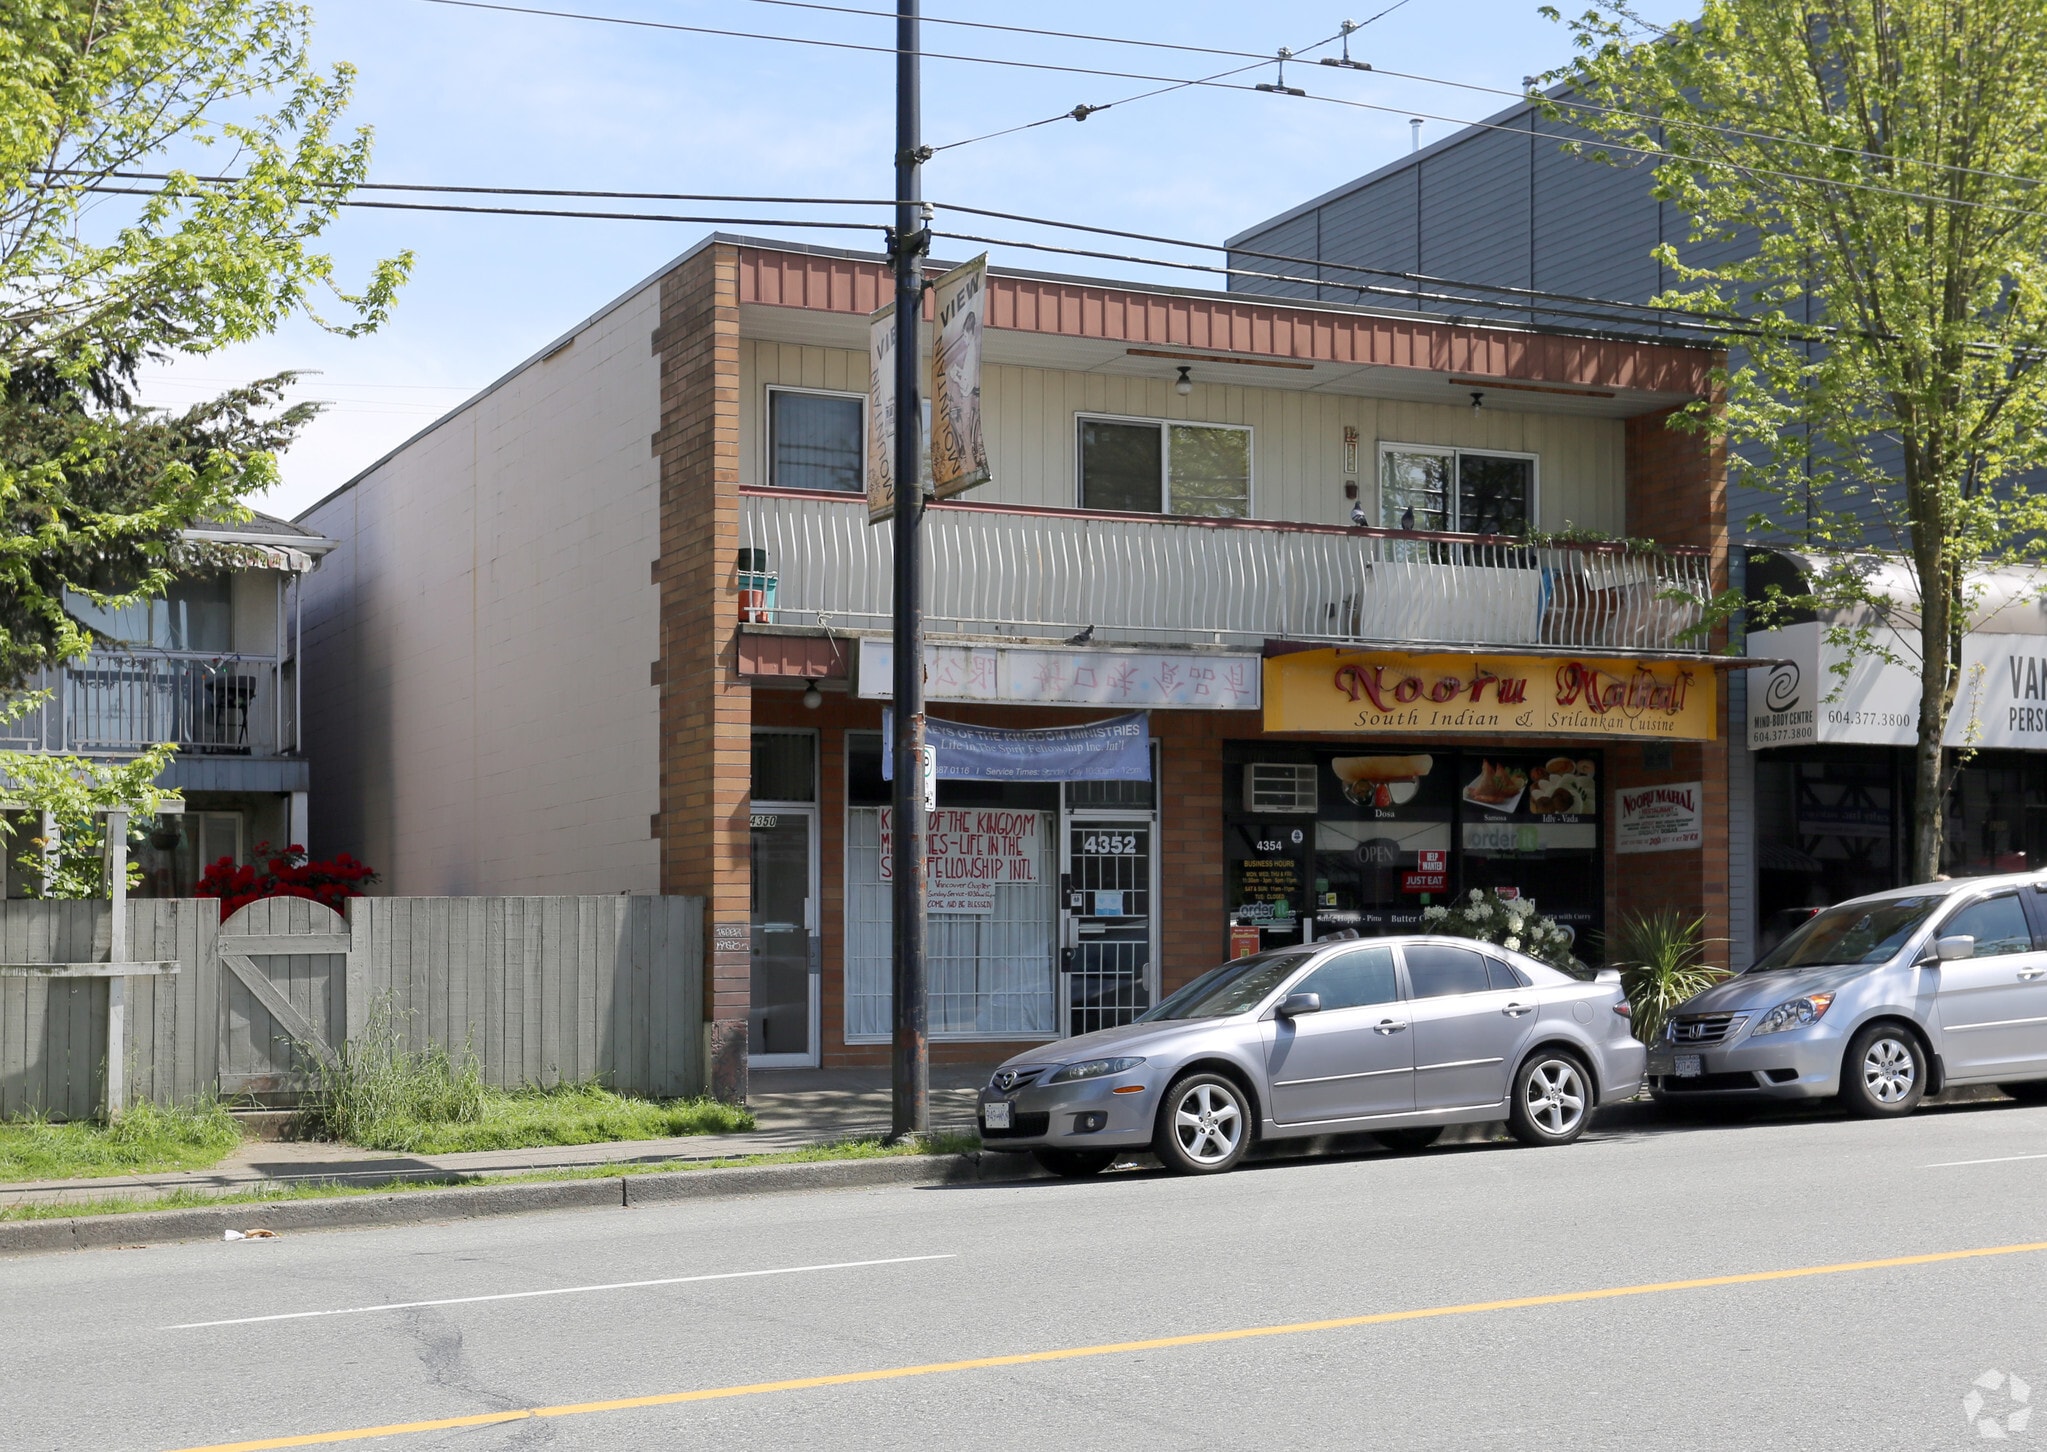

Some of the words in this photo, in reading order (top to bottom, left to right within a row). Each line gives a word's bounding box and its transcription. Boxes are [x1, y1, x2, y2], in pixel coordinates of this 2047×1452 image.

[940, 272, 980, 327] VIEW
[876, 324, 895, 361] VIE
[1334, 664, 1527, 712] Nooru
[1354, 709, 1418, 727] South
[1430, 709, 1499, 726] Indian
[1515, 710, 1533, 727] &
[1548, 711, 1624, 732] Srilankan
[1629, 716, 1675, 732] Cuisine
[1754, 712, 1789, 729] MIND-BODY
[1789, 710, 1813, 725] CENTRE
[1828, 710, 1910, 727] 604.377.3800
[2009, 707, 2047, 732] PERS
[958, 729, 975, 739] OF
[975, 730, 1001, 741] THE
[1003, 730, 1067, 742] KINGDOM
[1070, 724, 1140, 740] MINISTRIES
[1753, 727, 1812, 742] 604.377.3800
[941, 739, 962, 751] Life
[999, 744, 1026, 754] Spirit
[1028, 742, 1083, 754] Fellowship
[949, 766, 970, 775] 0116
[986, 767, 1014, 776] Service
[1015, 767, 1039, 776] Times:
[1655, 787, 1695, 813] MAHAL
[1375, 808, 1395, 818] Dosa
[1484, 814, 1507, 822] Samosa
[1561, 815, 1579, 823] Vada
[750, 816, 777, 827] 4350
[928, 811, 946, 832] OF
[947, 811, 972, 833] THE
[977, 812, 1035, 836] KINGDOM
[987, 835, 999, 856] IN
[1002, 836, 1023, 856] THE
[1083, 835, 1136, 854] 4352
[1256, 841, 1282, 850] 4354
[1358, 846, 1394, 864] OPEN
[1422, 861, 1443, 870] WANTED
[934, 880, 967, 889] Vancouver
[1406, 876, 1427, 885] JUST
[1427, 876, 1444, 885] EAT
[927, 900, 944, 908] COME
[1240, 901, 1275, 917] order
[1391, 915, 1417, 923] Butter
